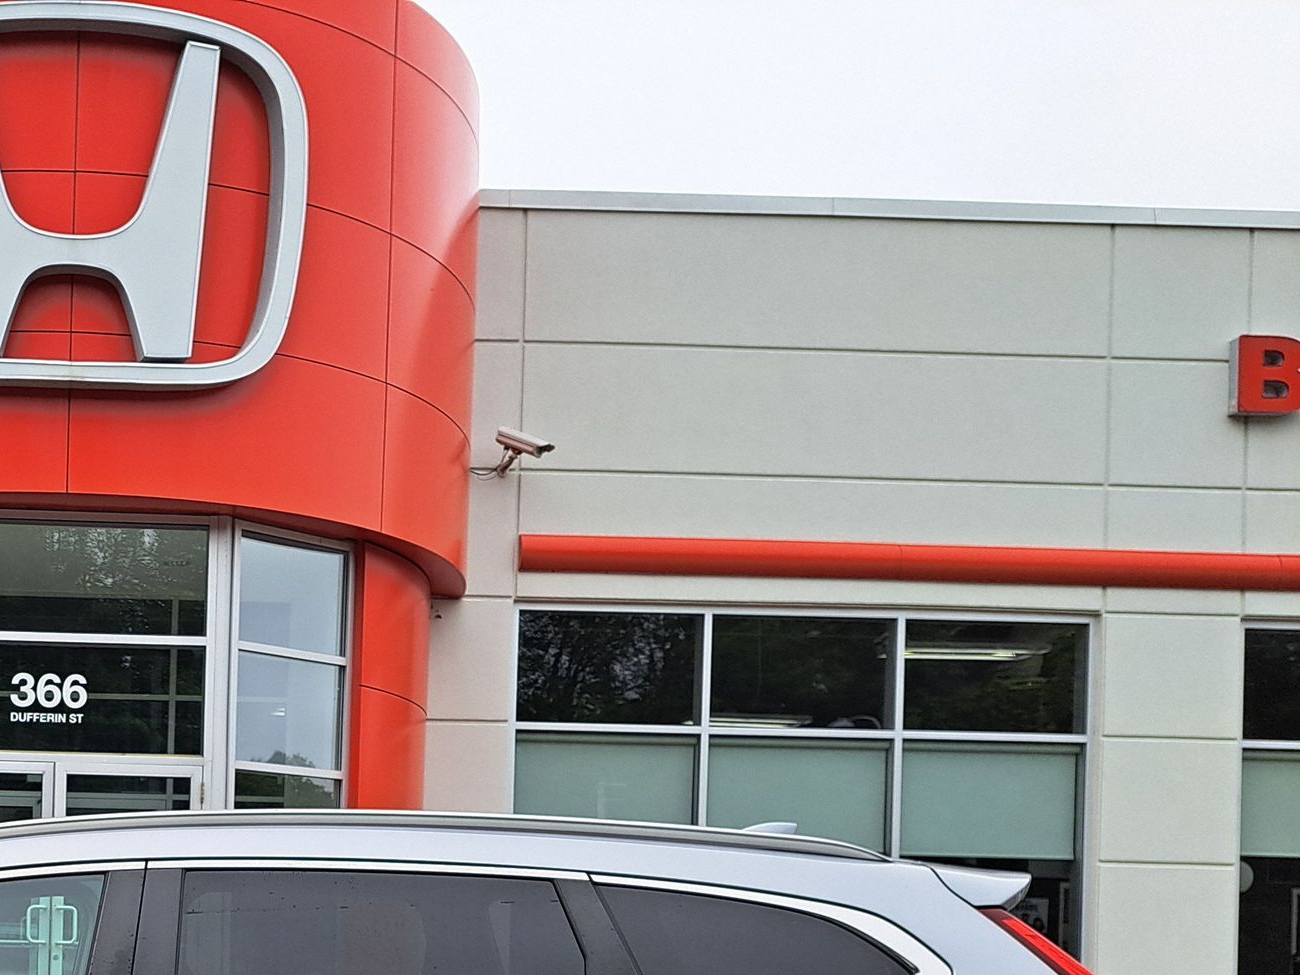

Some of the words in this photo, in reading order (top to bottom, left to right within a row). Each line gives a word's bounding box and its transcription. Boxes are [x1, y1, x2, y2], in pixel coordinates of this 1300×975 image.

[1233, 334, 1300, 416] B
[10, 672, 88, 709] 366
[10, 711, 67, 724] DUFFERIN
[68, 713, 84, 724] ST
